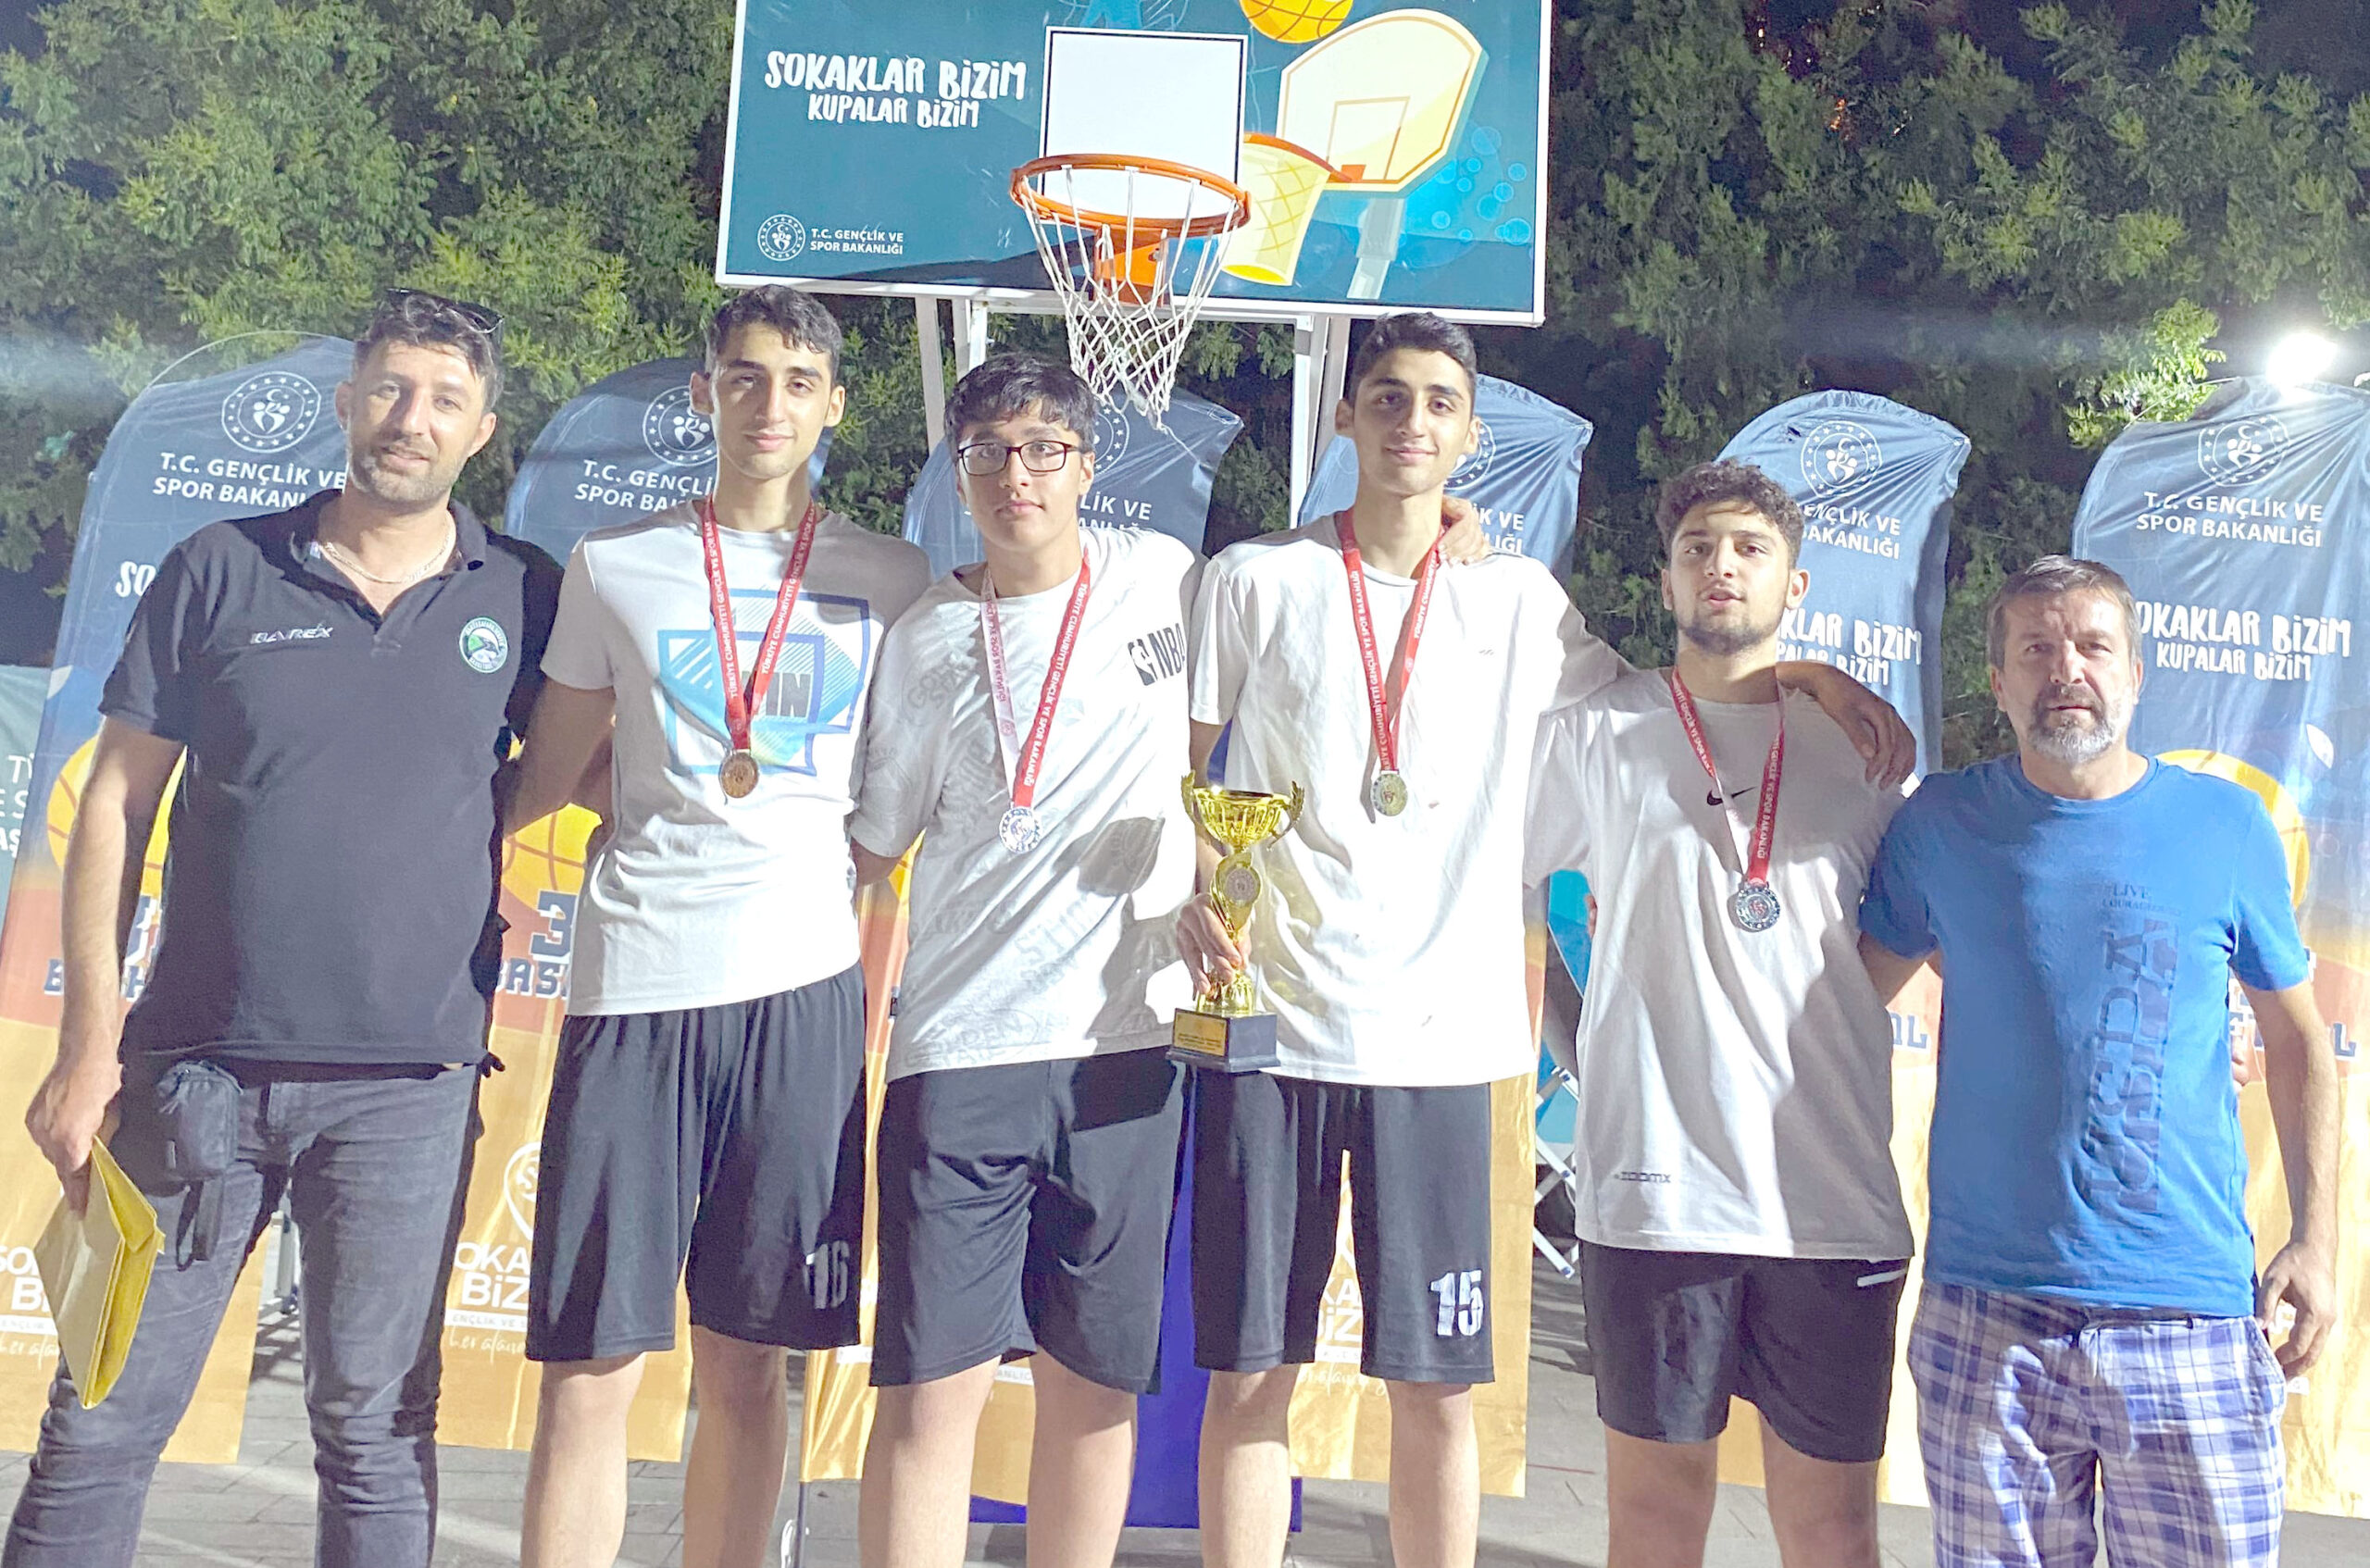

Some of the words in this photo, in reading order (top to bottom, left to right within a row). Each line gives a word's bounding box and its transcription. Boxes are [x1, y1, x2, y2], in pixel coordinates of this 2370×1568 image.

[765, 51, 925, 93] SOKAKLAR
[808, 93, 907, 123] KUPALAR
[810, 242, 841, 252] SPOR
[811, 229, 831, 239] T.C.
[888, 232, 904, 242] VE
[160, 453, 199, 474] T.C.
[207, 459, 310, 486] GENÇLİK
[318, 470, 346, 489] VE
[583, 460, 621, 483] T.C.
[153, 478, 212, 500] SPOR
[575, 483, 634, 508] SPOR
[1124, 500, 1153, 521] VE
[2187, 495, 2288, 519] GENÇLİK
[2294, 503, 2324, 522] VE
[1499, 511, 1524, 530] VE
[1876, 515, 1902, 535] VE
[2136, 514, 2197, 535] SPOR
[2202, 519, 2322, 548] BAKANLIĞI
[706, 537, 717, 557] SPOR
[1803, 525, 1901, 559] AKANLIĞI
[1358, 616, 1369, 636] SPOR
[2136, 601, 2260, 646] OKAKLAR
[1362, 638, 1372, 648] VE
[2156, 641, 2246, 674] KUPALAR
[1041, 705, 1051, 716] VE
[1034, 716, 1048, 739] SPOR
[1429, 1269, 1484, 1337] 15
